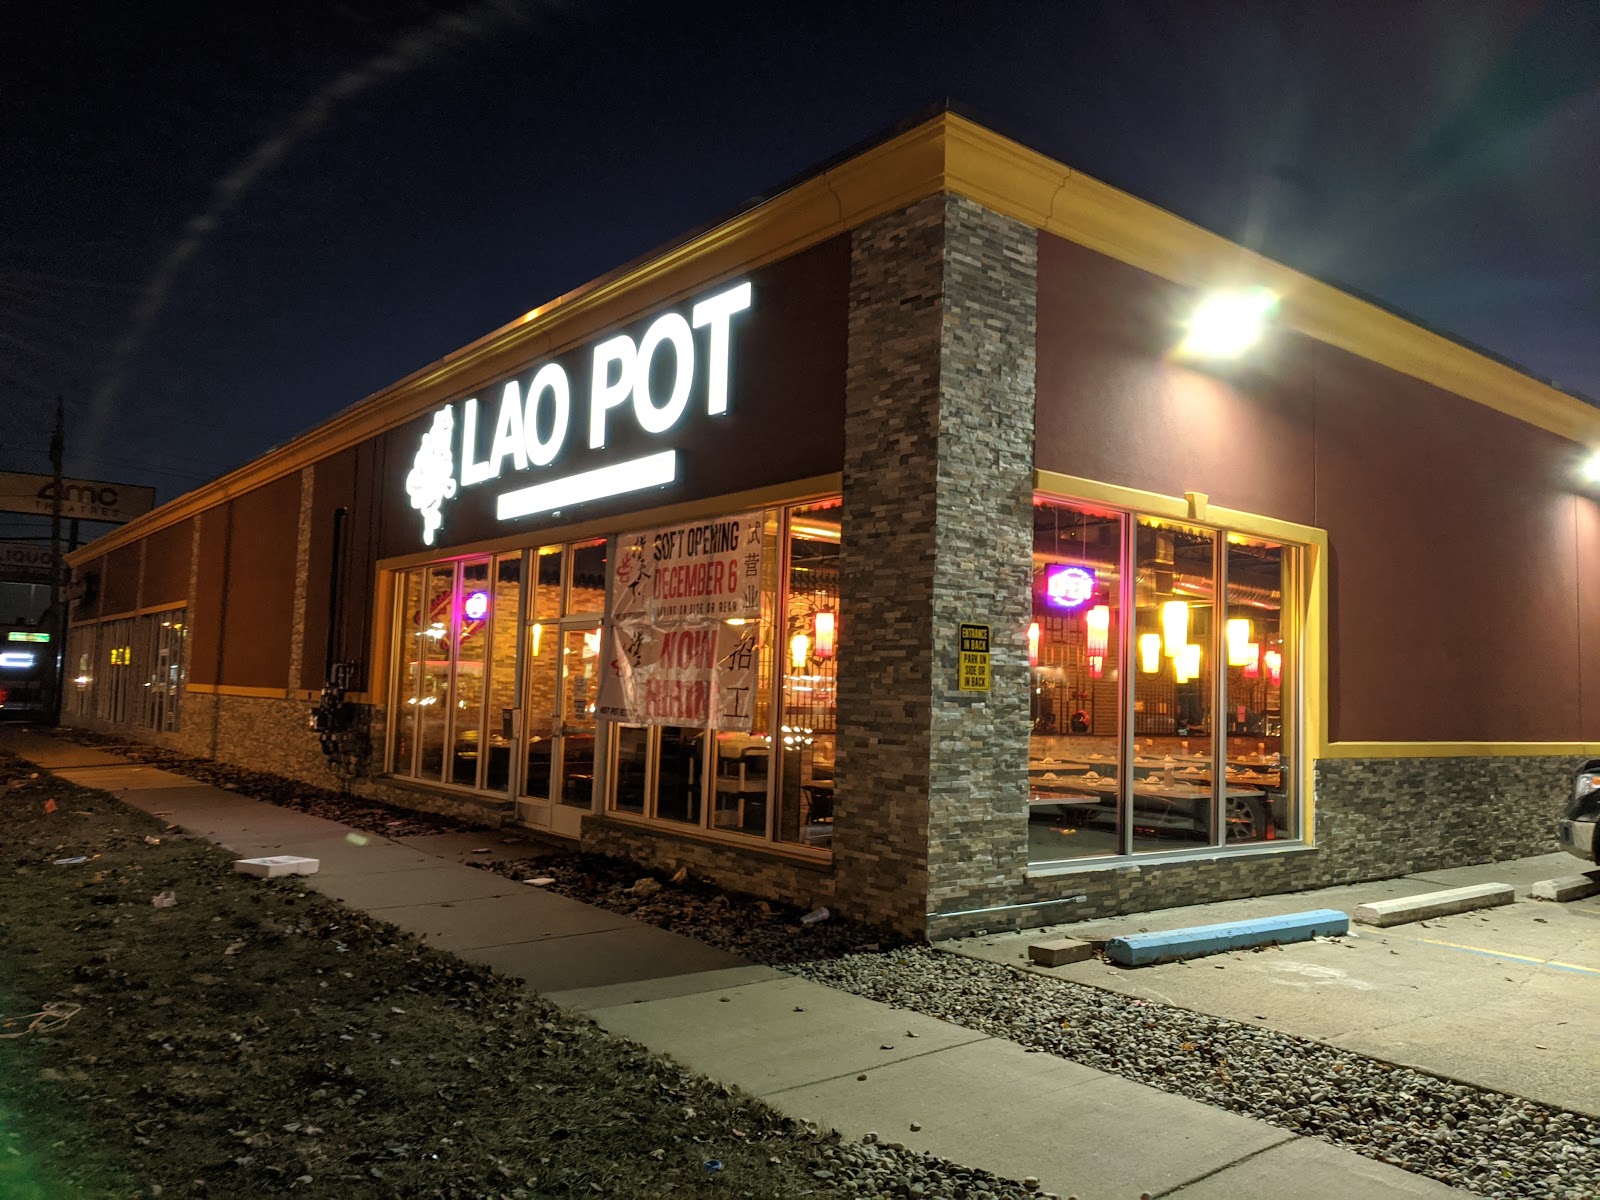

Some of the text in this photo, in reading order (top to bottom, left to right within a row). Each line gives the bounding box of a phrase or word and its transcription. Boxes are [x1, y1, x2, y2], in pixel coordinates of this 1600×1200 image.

[460, 281, 752, 487] LAO POT
[653, 521, 740, 562] SOFT OPENING
[653, 559, 737, 600] DECEMBER 6
[743, 521, 761, 609] 试营业
[690, 603, 704, 614] SIDE
[706, 602, 715, 613] OR
[719, 601, 738, 612] REAR
[660, 630, 717, 669] NOW
[962, 627, 988, 640] ENTRANCE
[964, 639, 987, 651] IN BACK
[723, 637, 754, 718] 招工
[963, 653, 987, 665] PARK ON
[965, 665, 986, 676] SIDE OR
[646, 680, 712, 719] HIRIN
[964, 677, 986, 687] IN BACK
